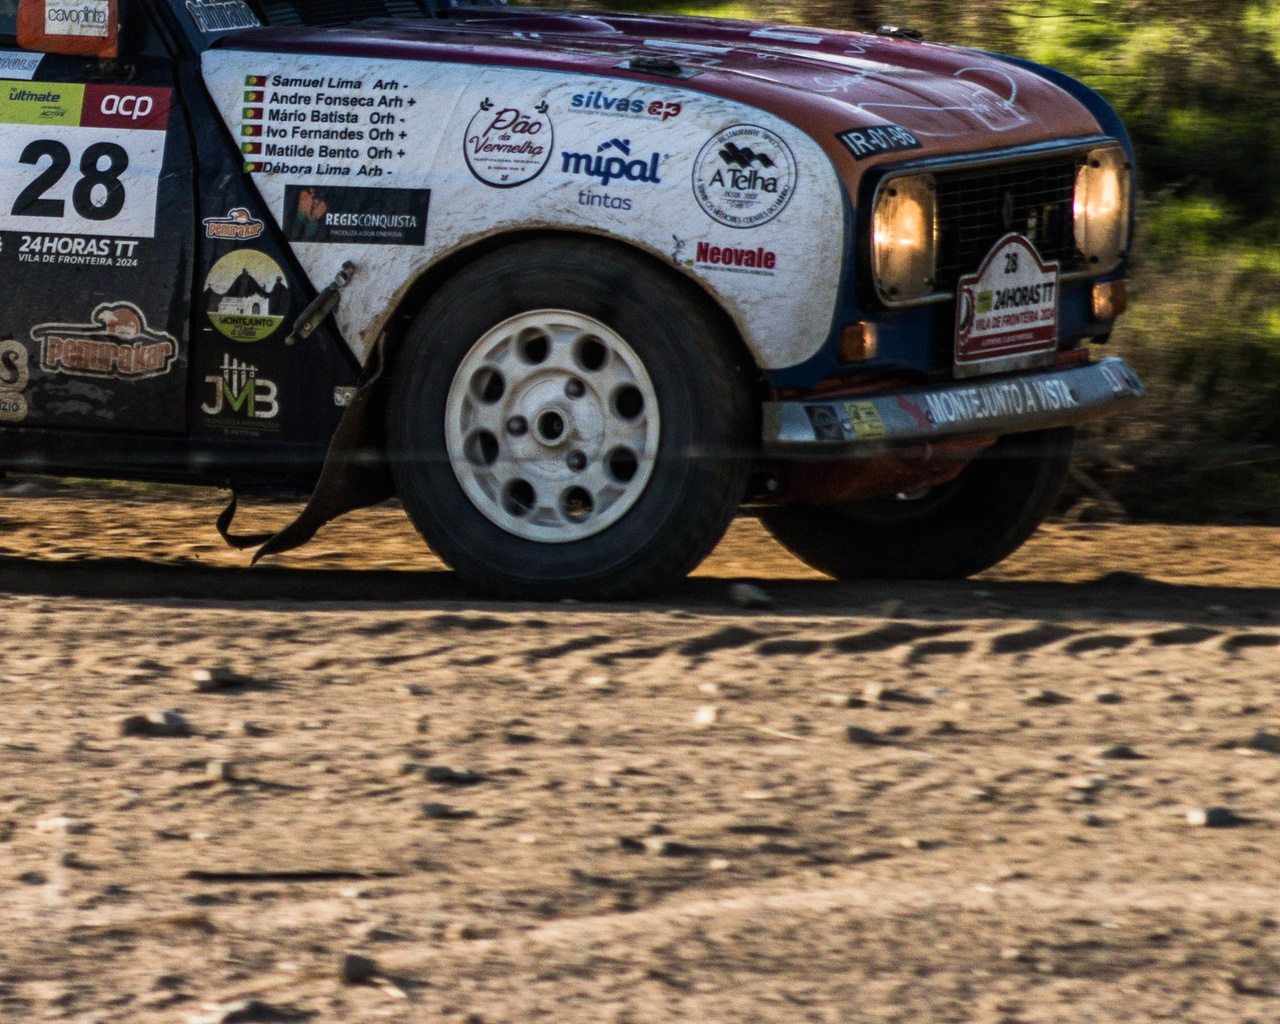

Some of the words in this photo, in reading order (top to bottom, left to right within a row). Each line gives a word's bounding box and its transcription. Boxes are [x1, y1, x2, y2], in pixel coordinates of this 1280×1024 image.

[271, 76, 324, 88] Samuel
[328, 77, 362, 90] Lima
[372, 79, 399, 91] Arh
[9, 89, 61, 102] ultimate
[100, 94, 154, 120] acp
[269, 92, 312, 105] Andre
[316, 93, 374, 107] Fonseca
[377, 95, 404, 108] Arh
[571, 91, 645, 113] silvas
[41, 110, 67, 118] ACTIVE
[268, 109, 307, 123] Mário
[311, 110, 359, 124] Batista
[369, 112, 395, 124] Orh
[482, 108, 542, 138] Pão
[266, 127, 287, 139] Ivo
[291, 128, 364, 141] Fernandes
[369, 128, 394, 141] Orh
[498, 132, 511, 141] da
[265, 144, 314, 158] Matilde
[319, 145, 359, 159] Bento
[367, 147, 393, 160] Orh
[469, 136, 544, 155] Vermelha
[262, 162, 312, 175] Débora
[316, 163, 351, 176] Lima
[357, 165, 383, 177] Arh
[561, 151, 662, 186] mipal
[10, 139, 130, 221] 28
[708, 169, 725, 188] A
[726, 168, 778, 193] Telha
[578, 189, 632, 211] tintas
[325, 212, 418, 228] REGISCONQUISTA
[19, 236, 111, 256] 24HORAS
[114, 241, 139, 257] TT
[695, 241, 776, 269] Neovale
[19, 253, 40, 263] VILA
[42, 255, 56, 264] DE
[57, 256, 113, 267] FRONTEIRA
[115, 258, 138, 268] 2024
[1005, 252, 1018, 274] 28
[201, 375, 279, 418] JMB
